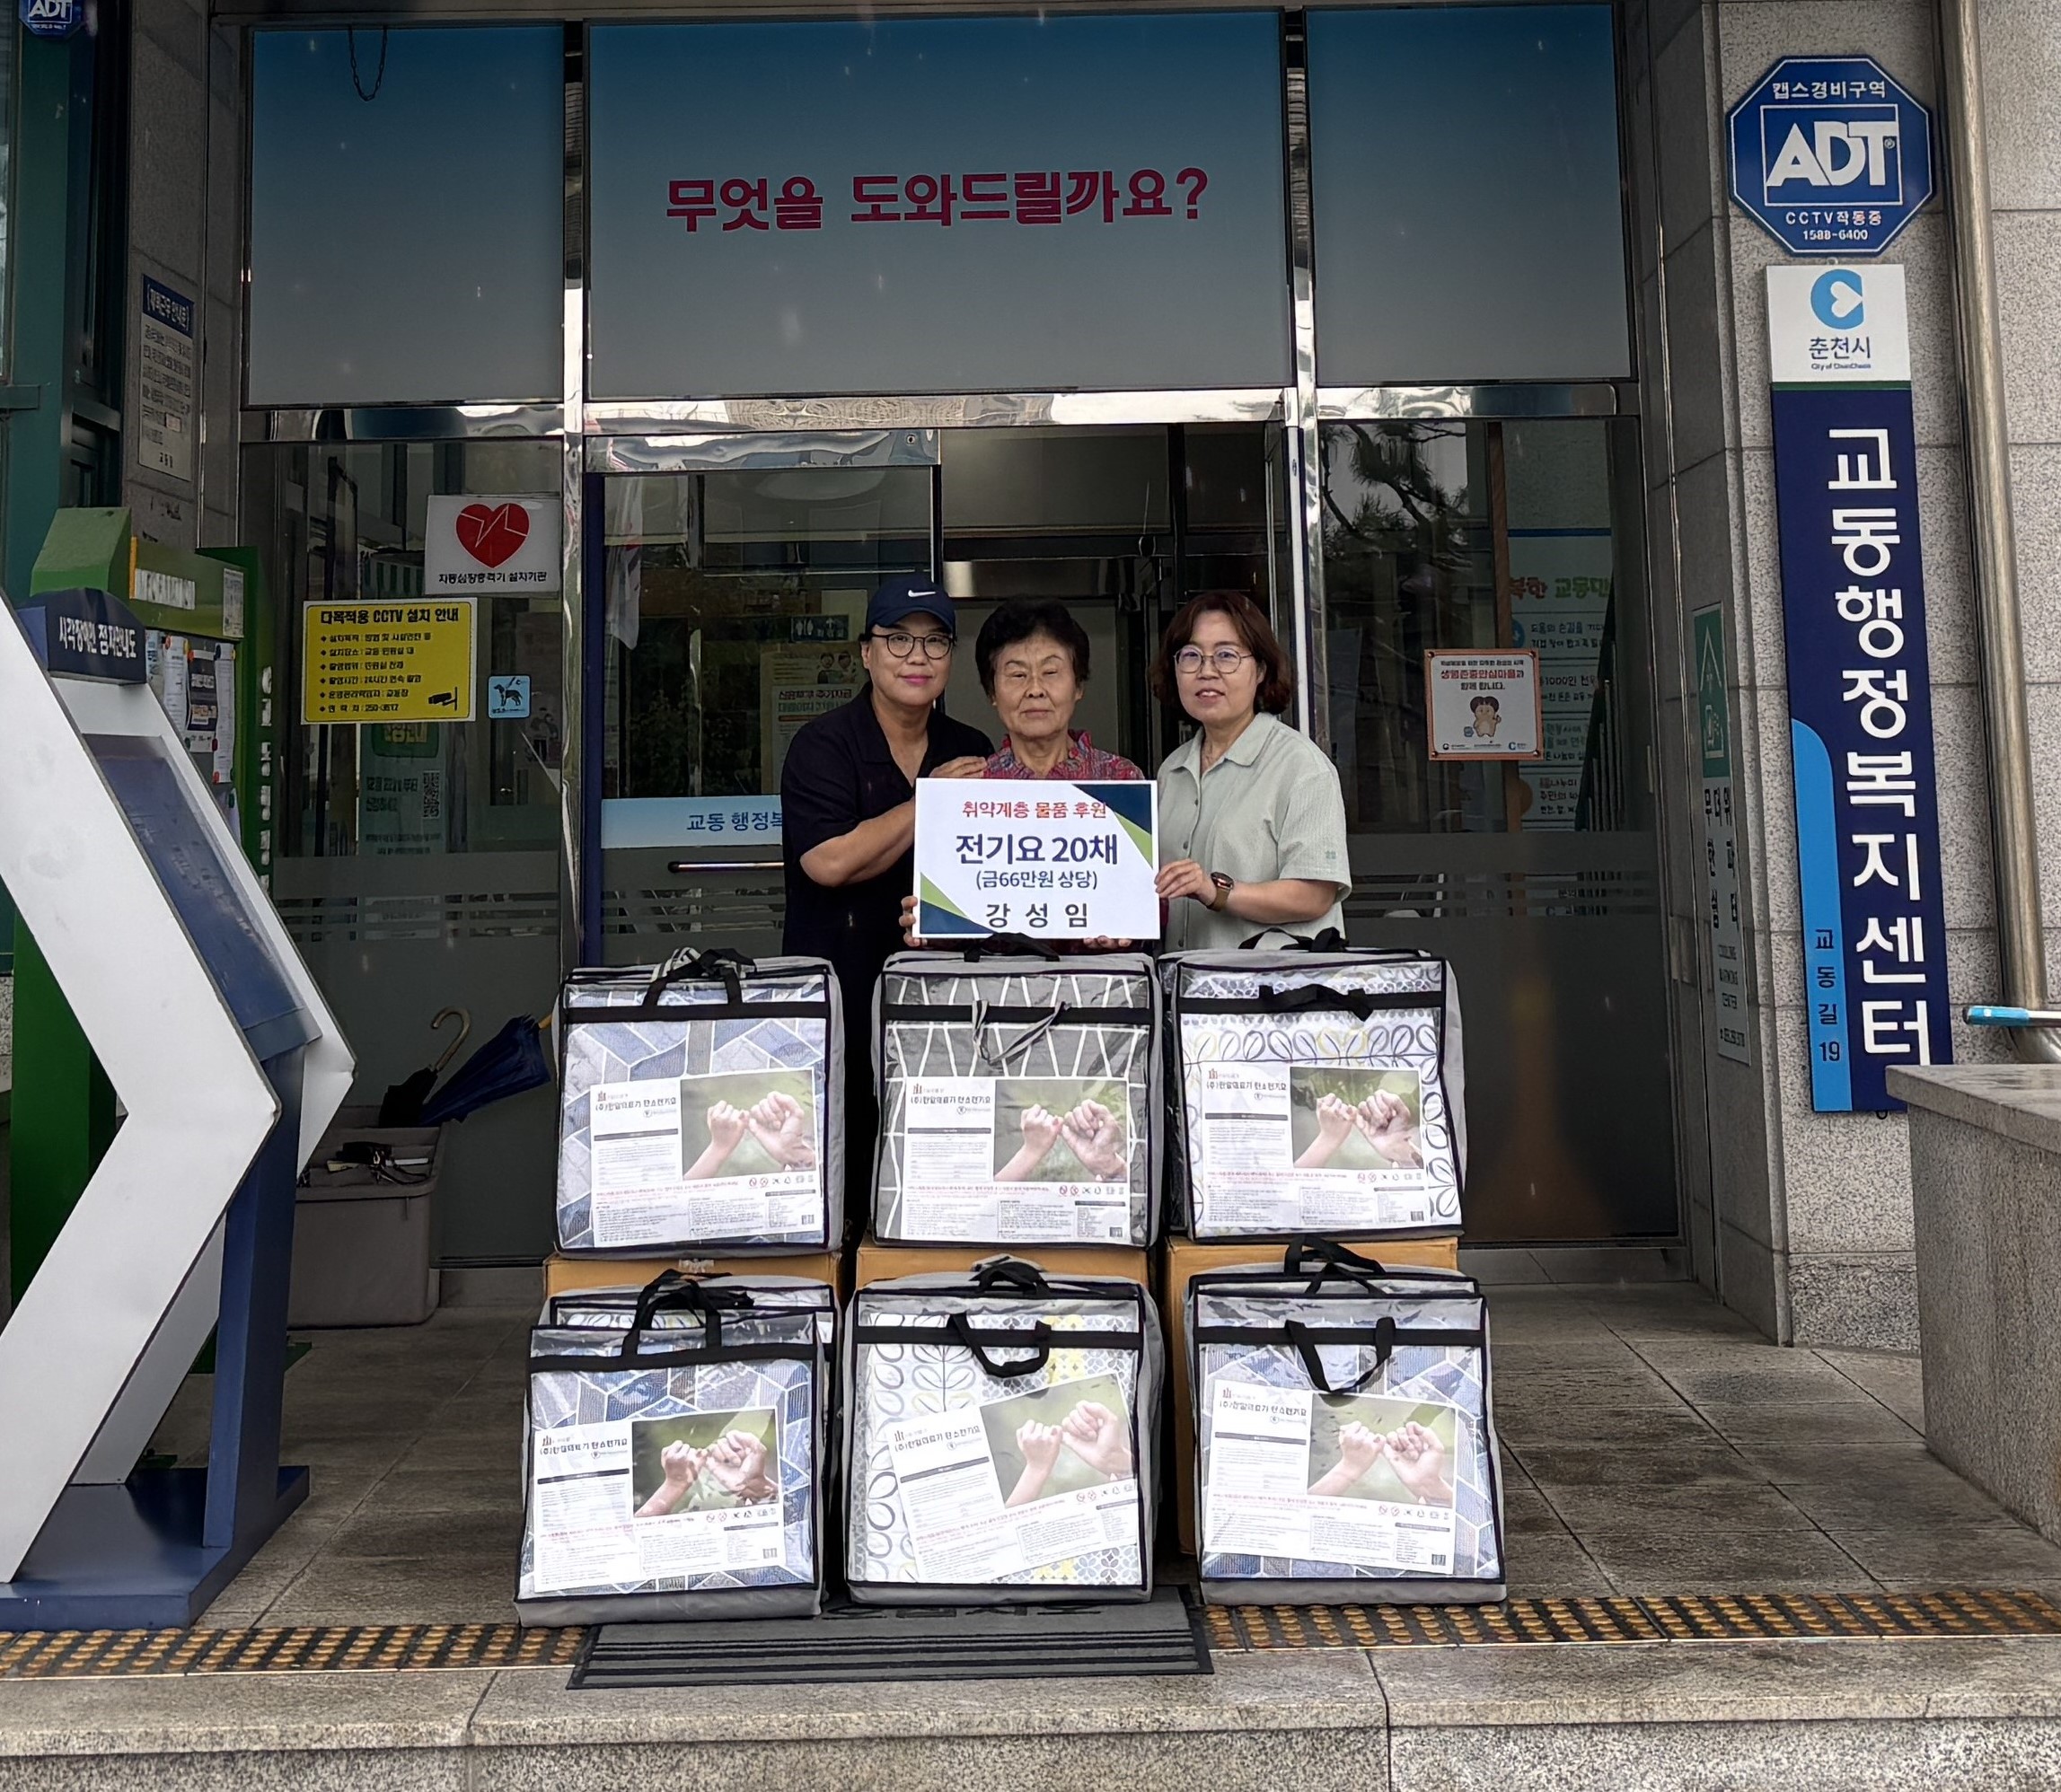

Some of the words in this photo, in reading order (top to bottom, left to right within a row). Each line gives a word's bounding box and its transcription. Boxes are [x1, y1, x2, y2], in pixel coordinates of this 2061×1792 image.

[28, 0, 72, 18] ADT
[1772, 80, 1886, 100] 캡스경비구역
[1766, 121, 1898, 186] ADT
[667, 176, 824, 232] 무엇을
[850, 167, 1209, 226] 도와드릴까요?
[1785, 211, 1882, 226] CCTV작동중
[1802, 228, 1869, 241] 1588-6400
[1808, 336, 1872, 359] 춘천시
[438, 573, 506, 584] 자동심장충격기
[508, 571, 548, 583] 설치기관
[321, 610, 369, 625] 다목적용
[373, 610, 403, 624] CCTV
[407, 609, 430, 623] 설치
[435, 608, 459, 622] 안내
[1827, 426, 1932, 1067] 교동행정복지센터
[962, 801, 1029, 819] 취약계층
[1035, 801, 1068, 819] 물품
[1073, 801, 1107, 819] 후원
[686, 812, 726, 832] 교동
[955, 833, 1046, 865] 전기요
[1052, 833, 1118, 865] 20채
[975, 871, 1054, 890] (금66만원
[1058, 871, 1098, 890] 상당)
[1818, 1041, 1841, 1063] 19
